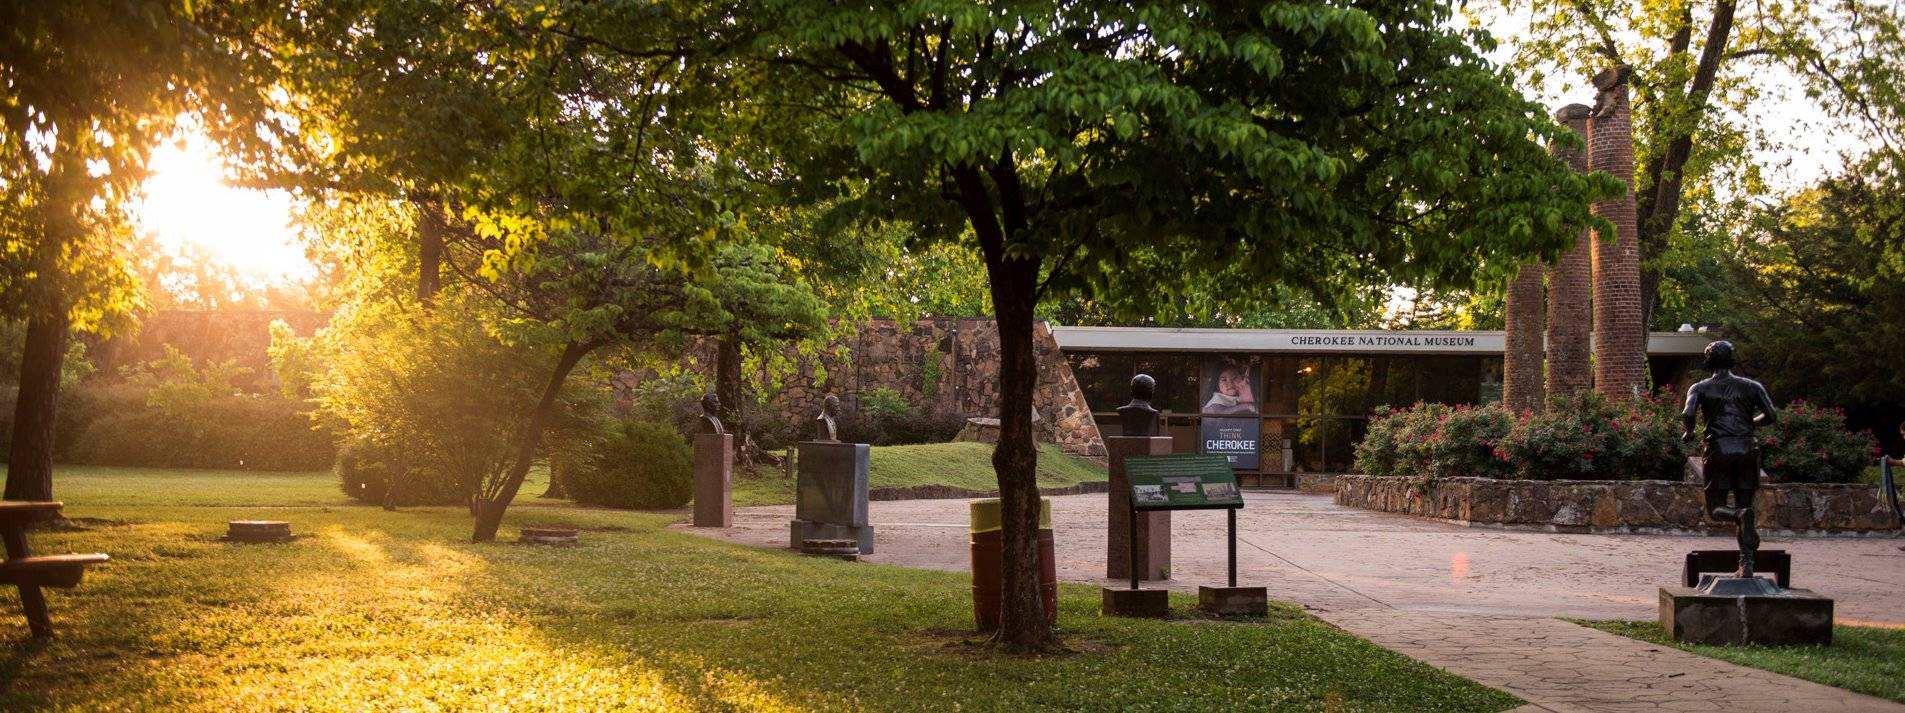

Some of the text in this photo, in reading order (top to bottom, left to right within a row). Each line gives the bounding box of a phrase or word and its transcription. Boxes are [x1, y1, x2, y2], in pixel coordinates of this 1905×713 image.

[1291, 336, 1474, 346] CHEROKEE NATIONAL MUSEUM
[1206, 440, 1255, 449] CHEROKEE
